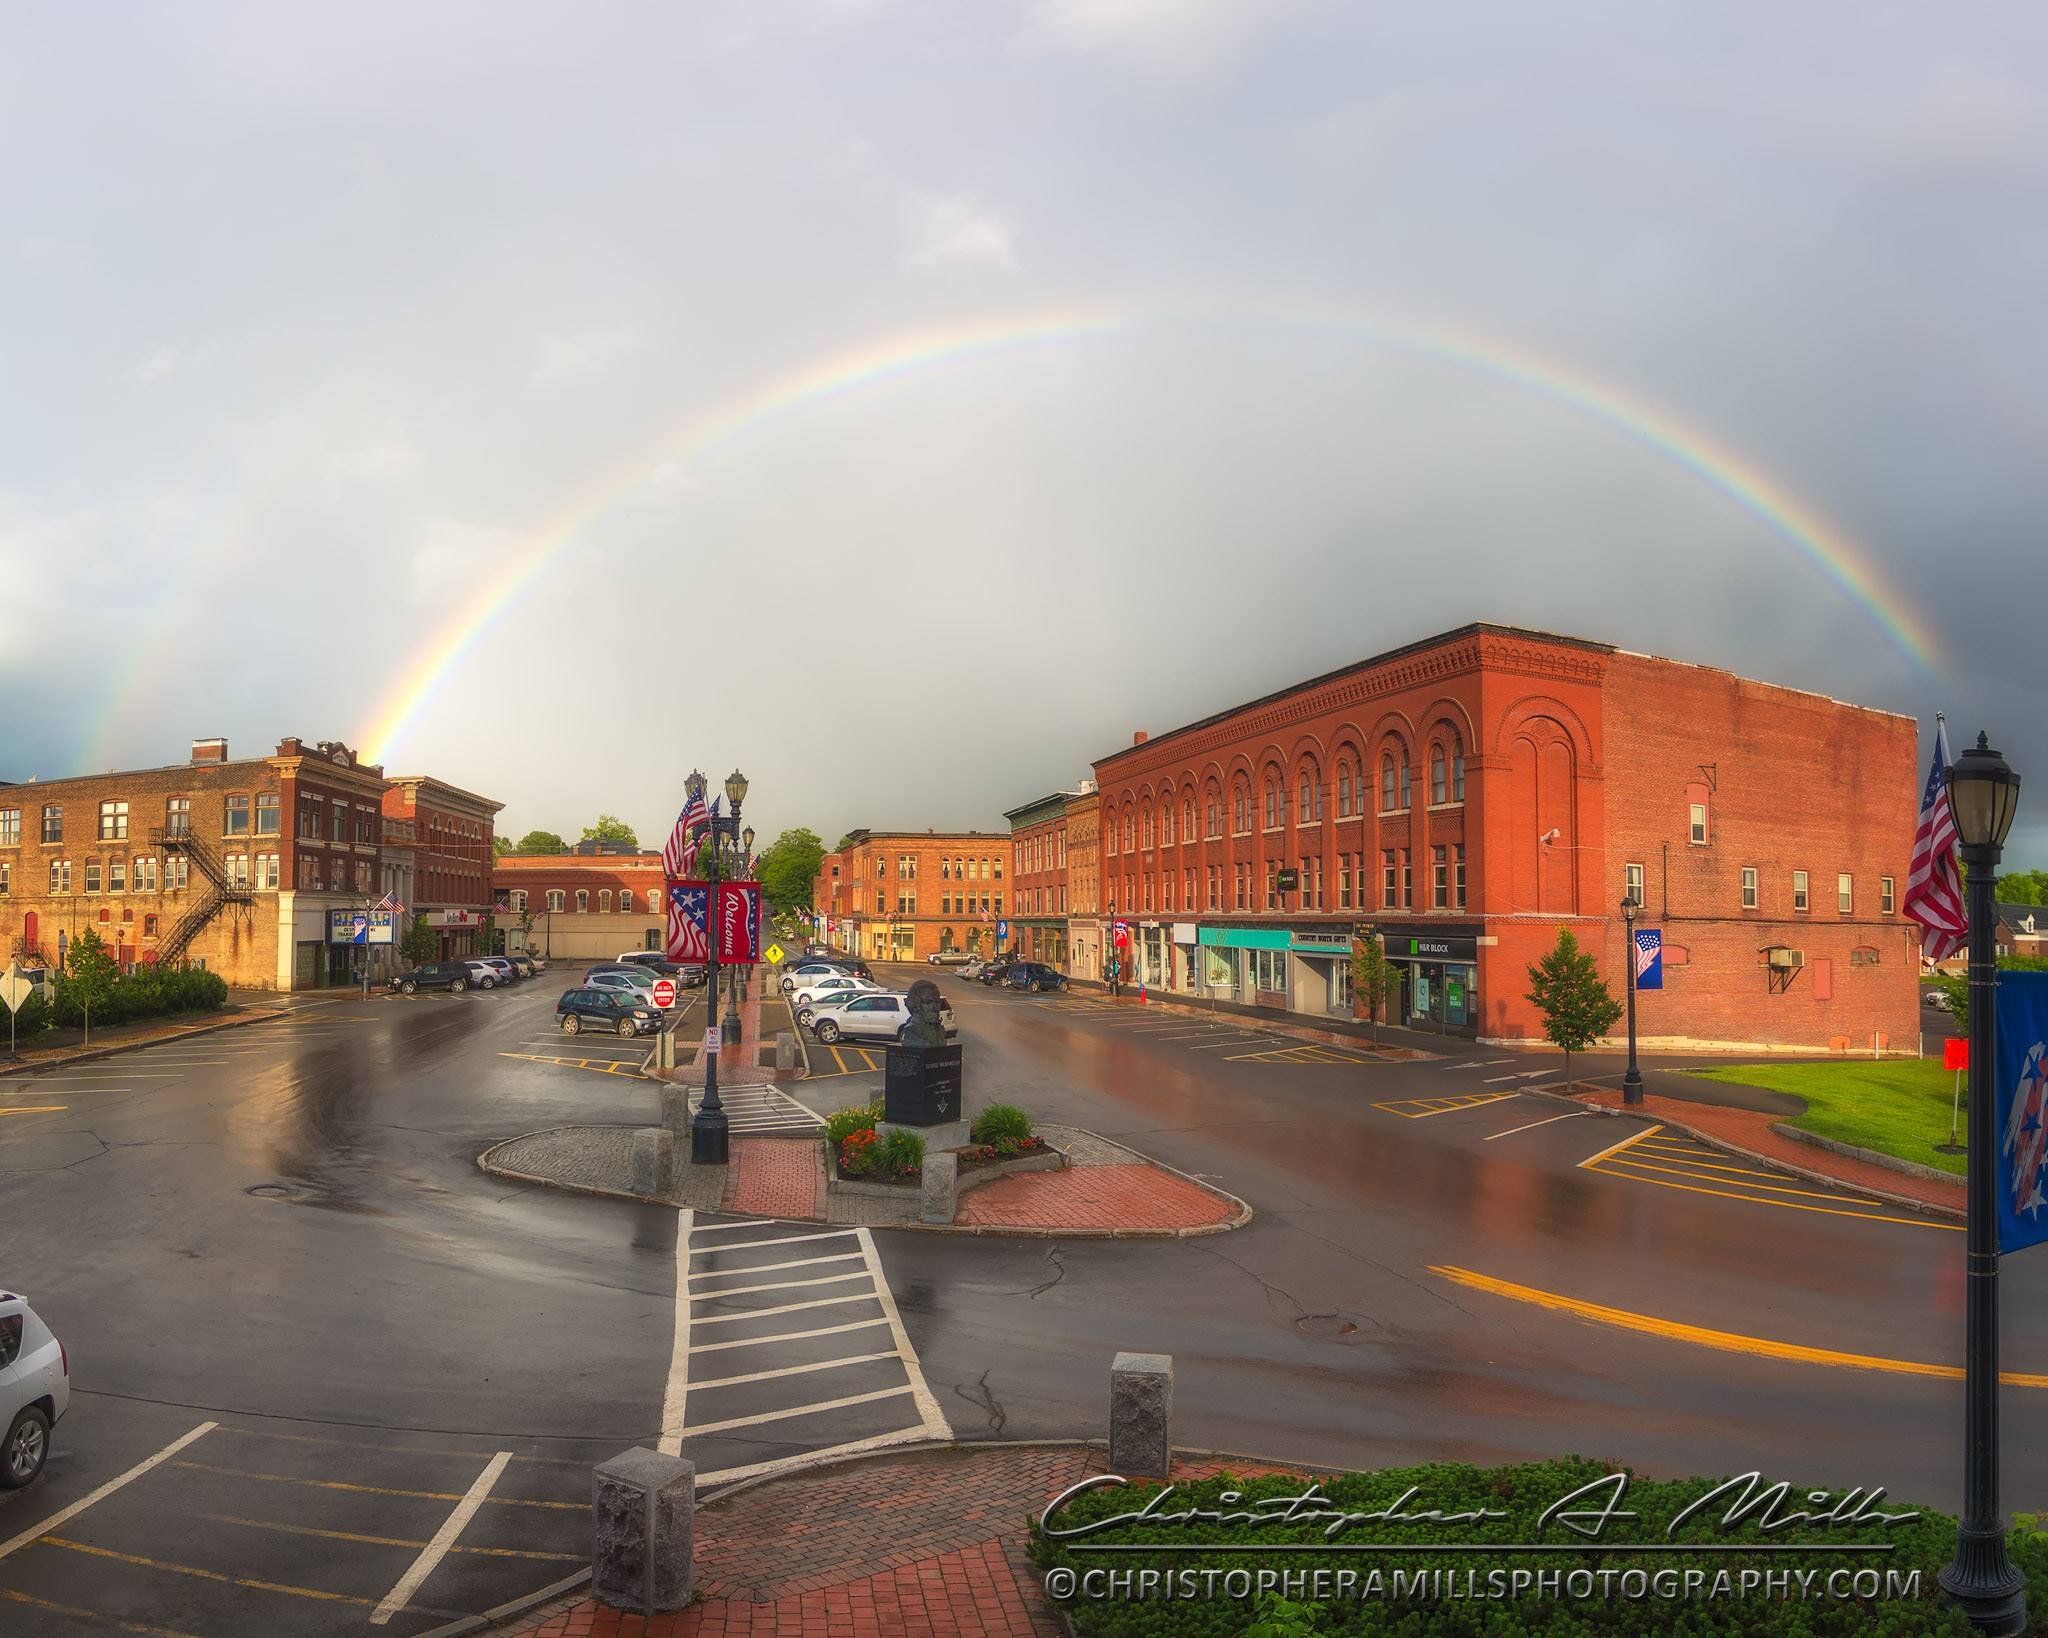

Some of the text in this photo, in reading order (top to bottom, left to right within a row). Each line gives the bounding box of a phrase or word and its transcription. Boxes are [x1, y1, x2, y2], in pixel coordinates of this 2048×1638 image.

[725, 892, 739, 955] Welcome
[1333, 935, 1347, 943] GIFTS
[1419, 944, 1449, 952] H&R BLOCK
[708, 1028, 718, 1036] NO
